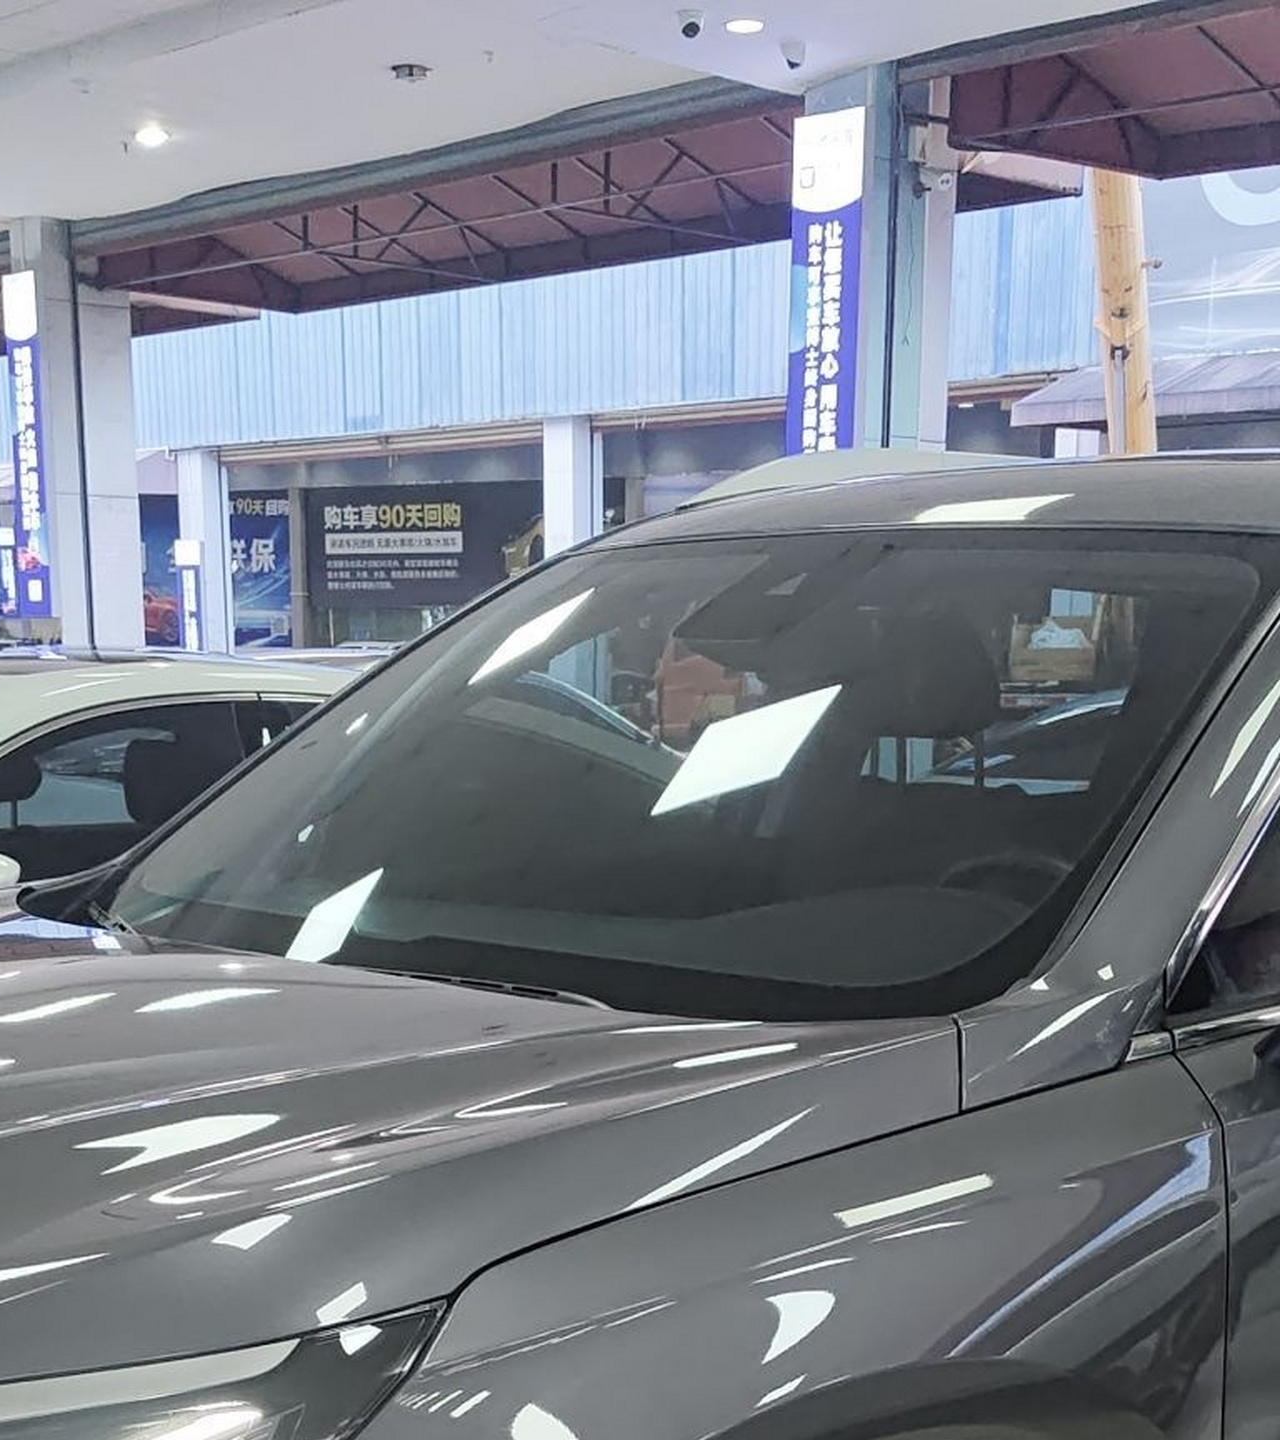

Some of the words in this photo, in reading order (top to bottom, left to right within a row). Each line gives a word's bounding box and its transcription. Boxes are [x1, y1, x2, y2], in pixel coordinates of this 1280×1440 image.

[324, 502, 462, 530] 购车享90天回购
